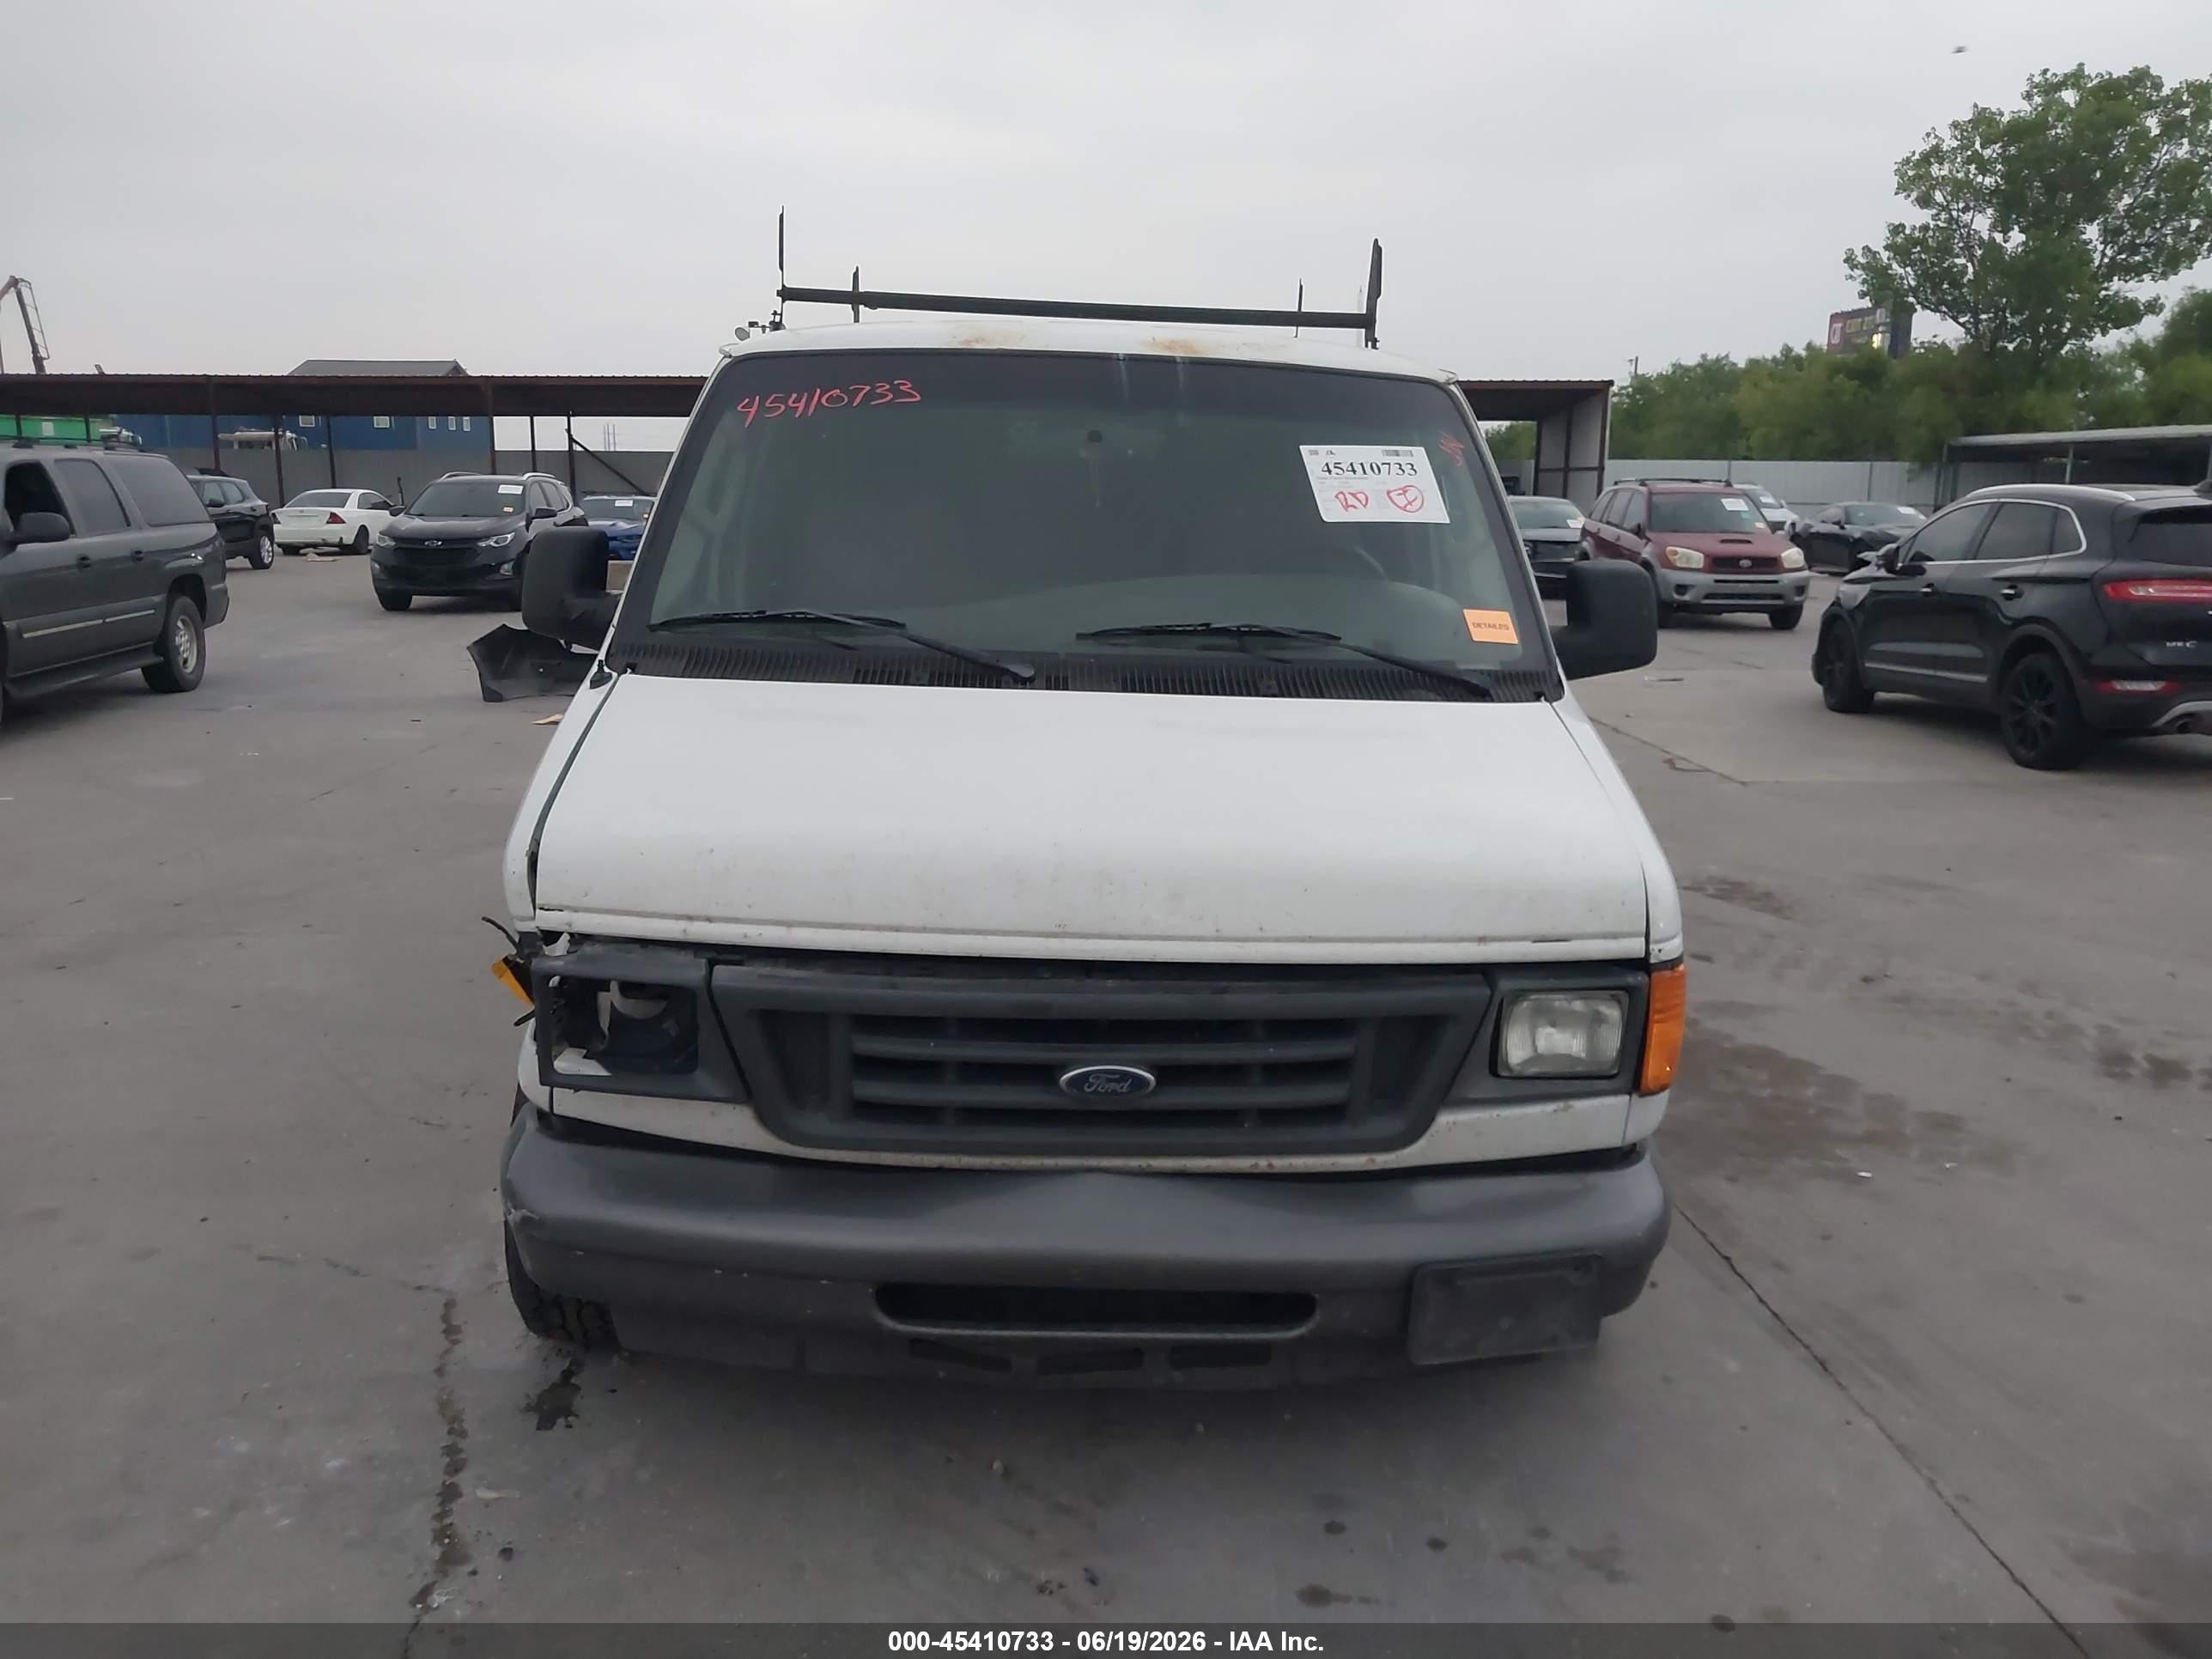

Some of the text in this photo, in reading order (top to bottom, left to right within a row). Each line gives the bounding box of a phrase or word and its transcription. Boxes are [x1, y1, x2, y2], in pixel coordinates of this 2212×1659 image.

[737, 380, 921, 428] 45410733
[1321, 462, 1418, 476] 45410733
[1472, 622, 1510, 630] DETAILED
[1084, 1073, 1133, 1092] Ford
